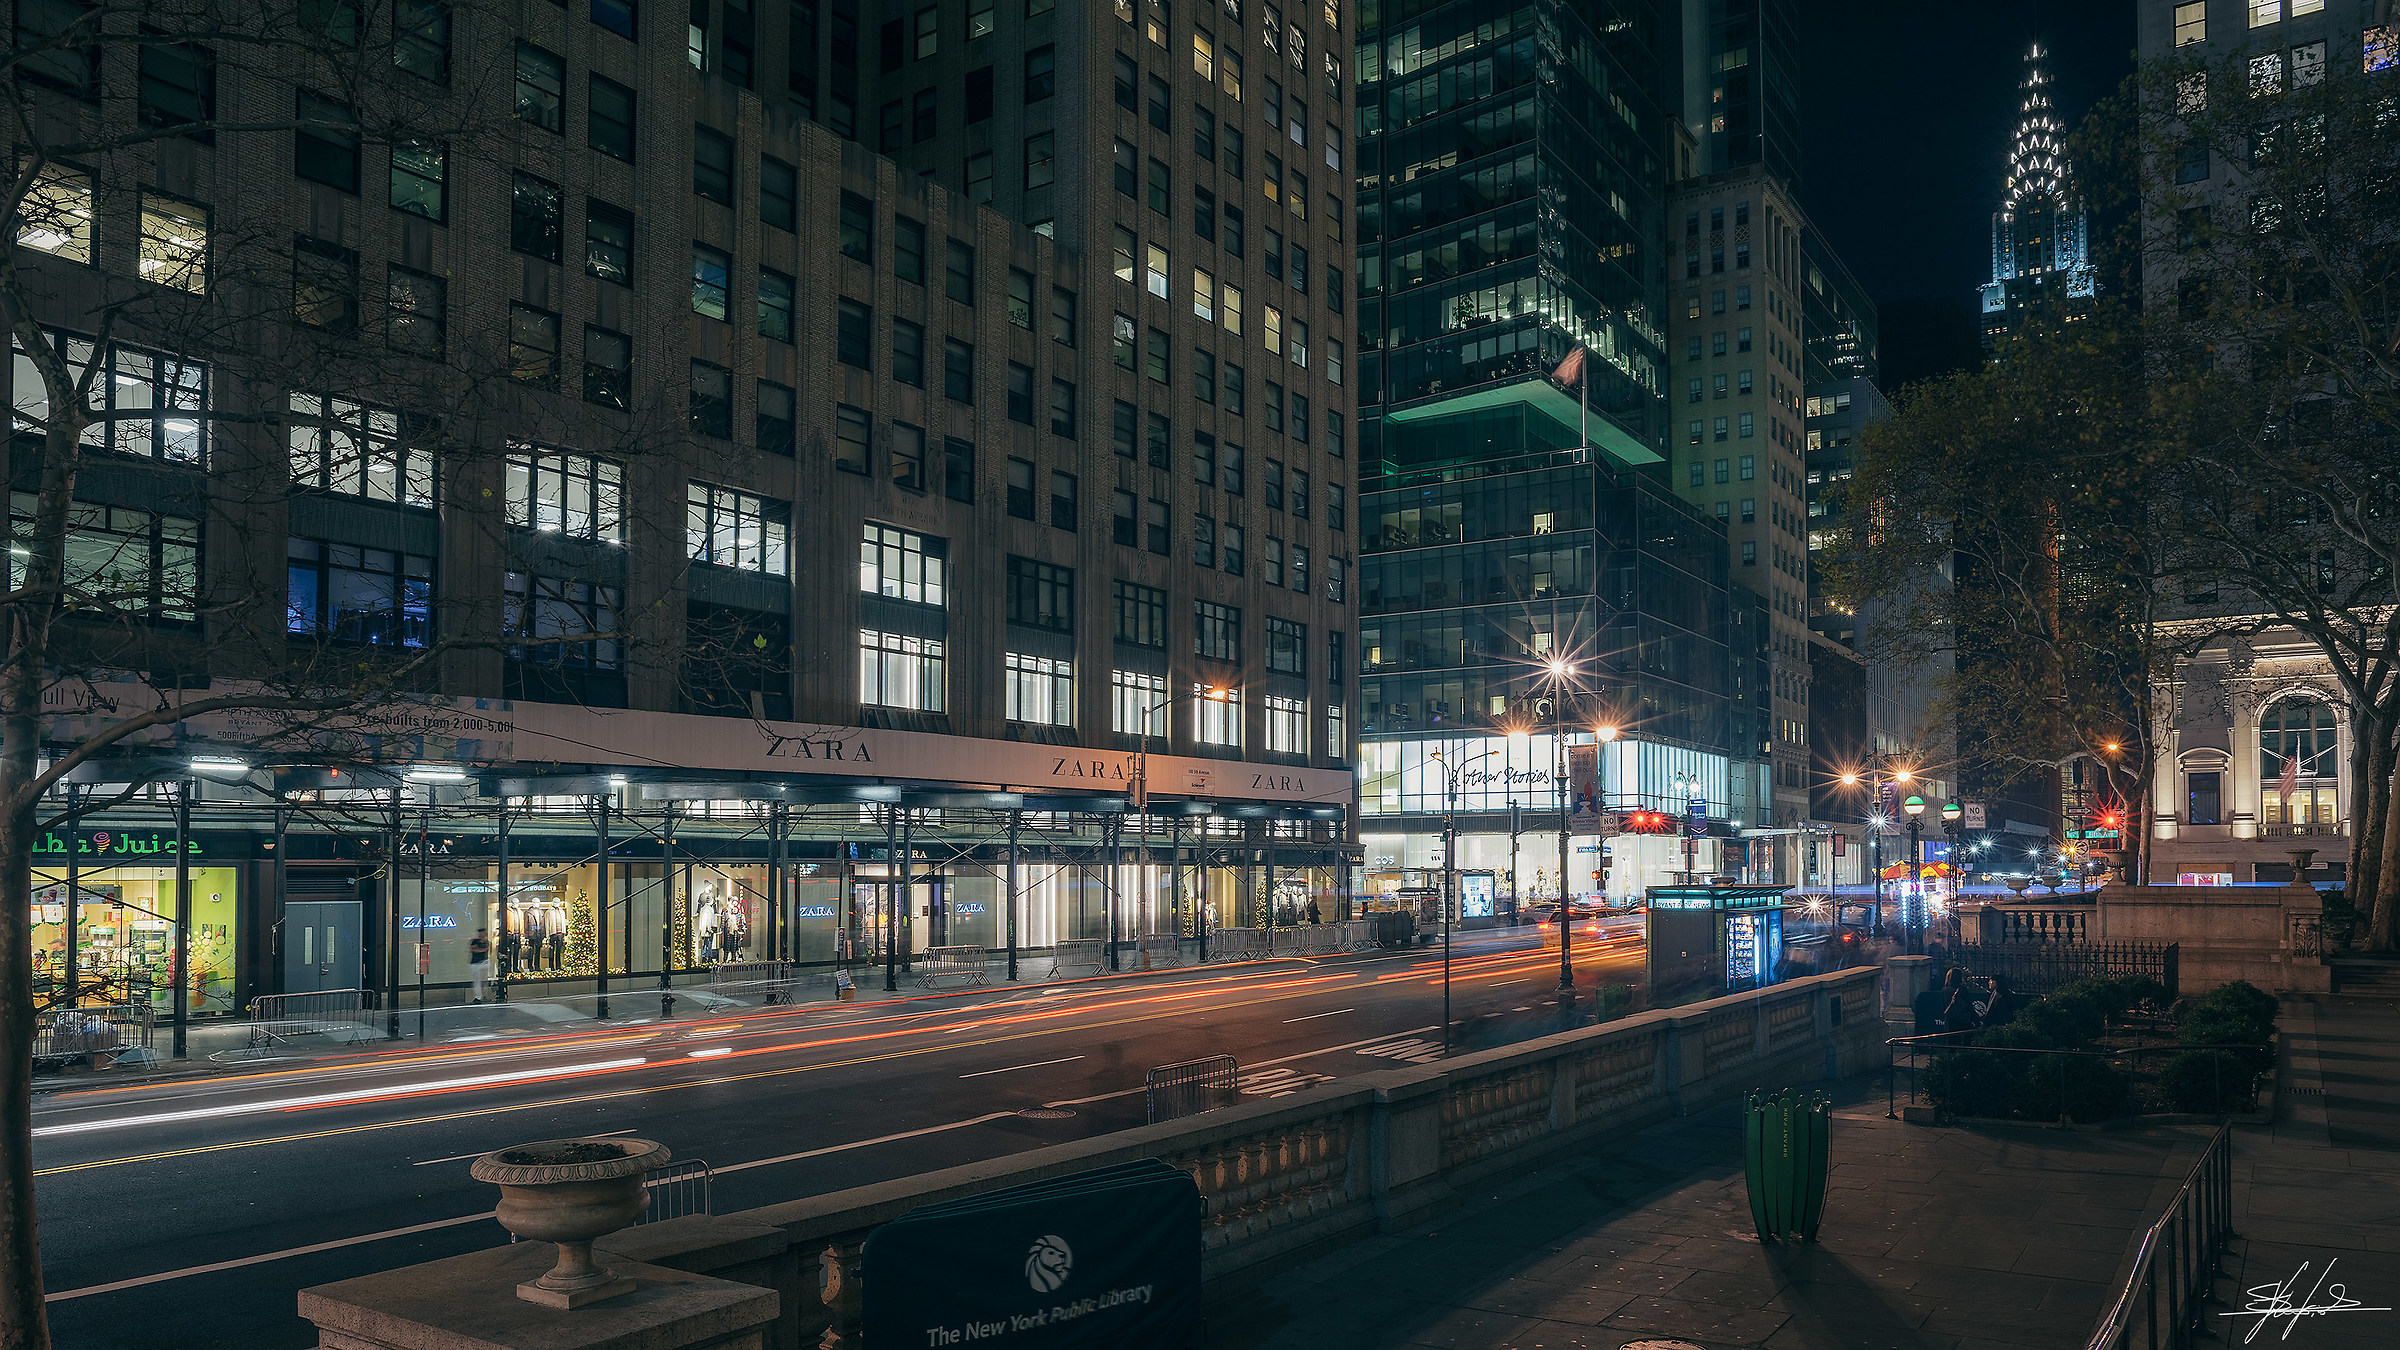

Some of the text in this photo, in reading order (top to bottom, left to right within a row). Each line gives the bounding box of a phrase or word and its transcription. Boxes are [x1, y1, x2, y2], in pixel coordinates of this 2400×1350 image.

[766, 735, 874, 762] ZARA
[1052, 757, 1125, 780] ZARA
[1503, 766, 1550, 785] Stories
[1251, 773, 1306, 792] ZARA
[1970, 807, 1980, 815] NO
[1604, 817, 1614, 825] NO
[113, 833, 203, 854] Juice
[399, 843, 450, 855] ZARA
[896, 849, 928, 859] ZRA
[1374, 856, 1395, 865] COS
[799, 906, 835, 917] ZARA
[956, 903, 985, 913] ZARA
[402, 915, 456, 929] ZARA
[926, 1284, 1153, 1347] The New York Public Library
